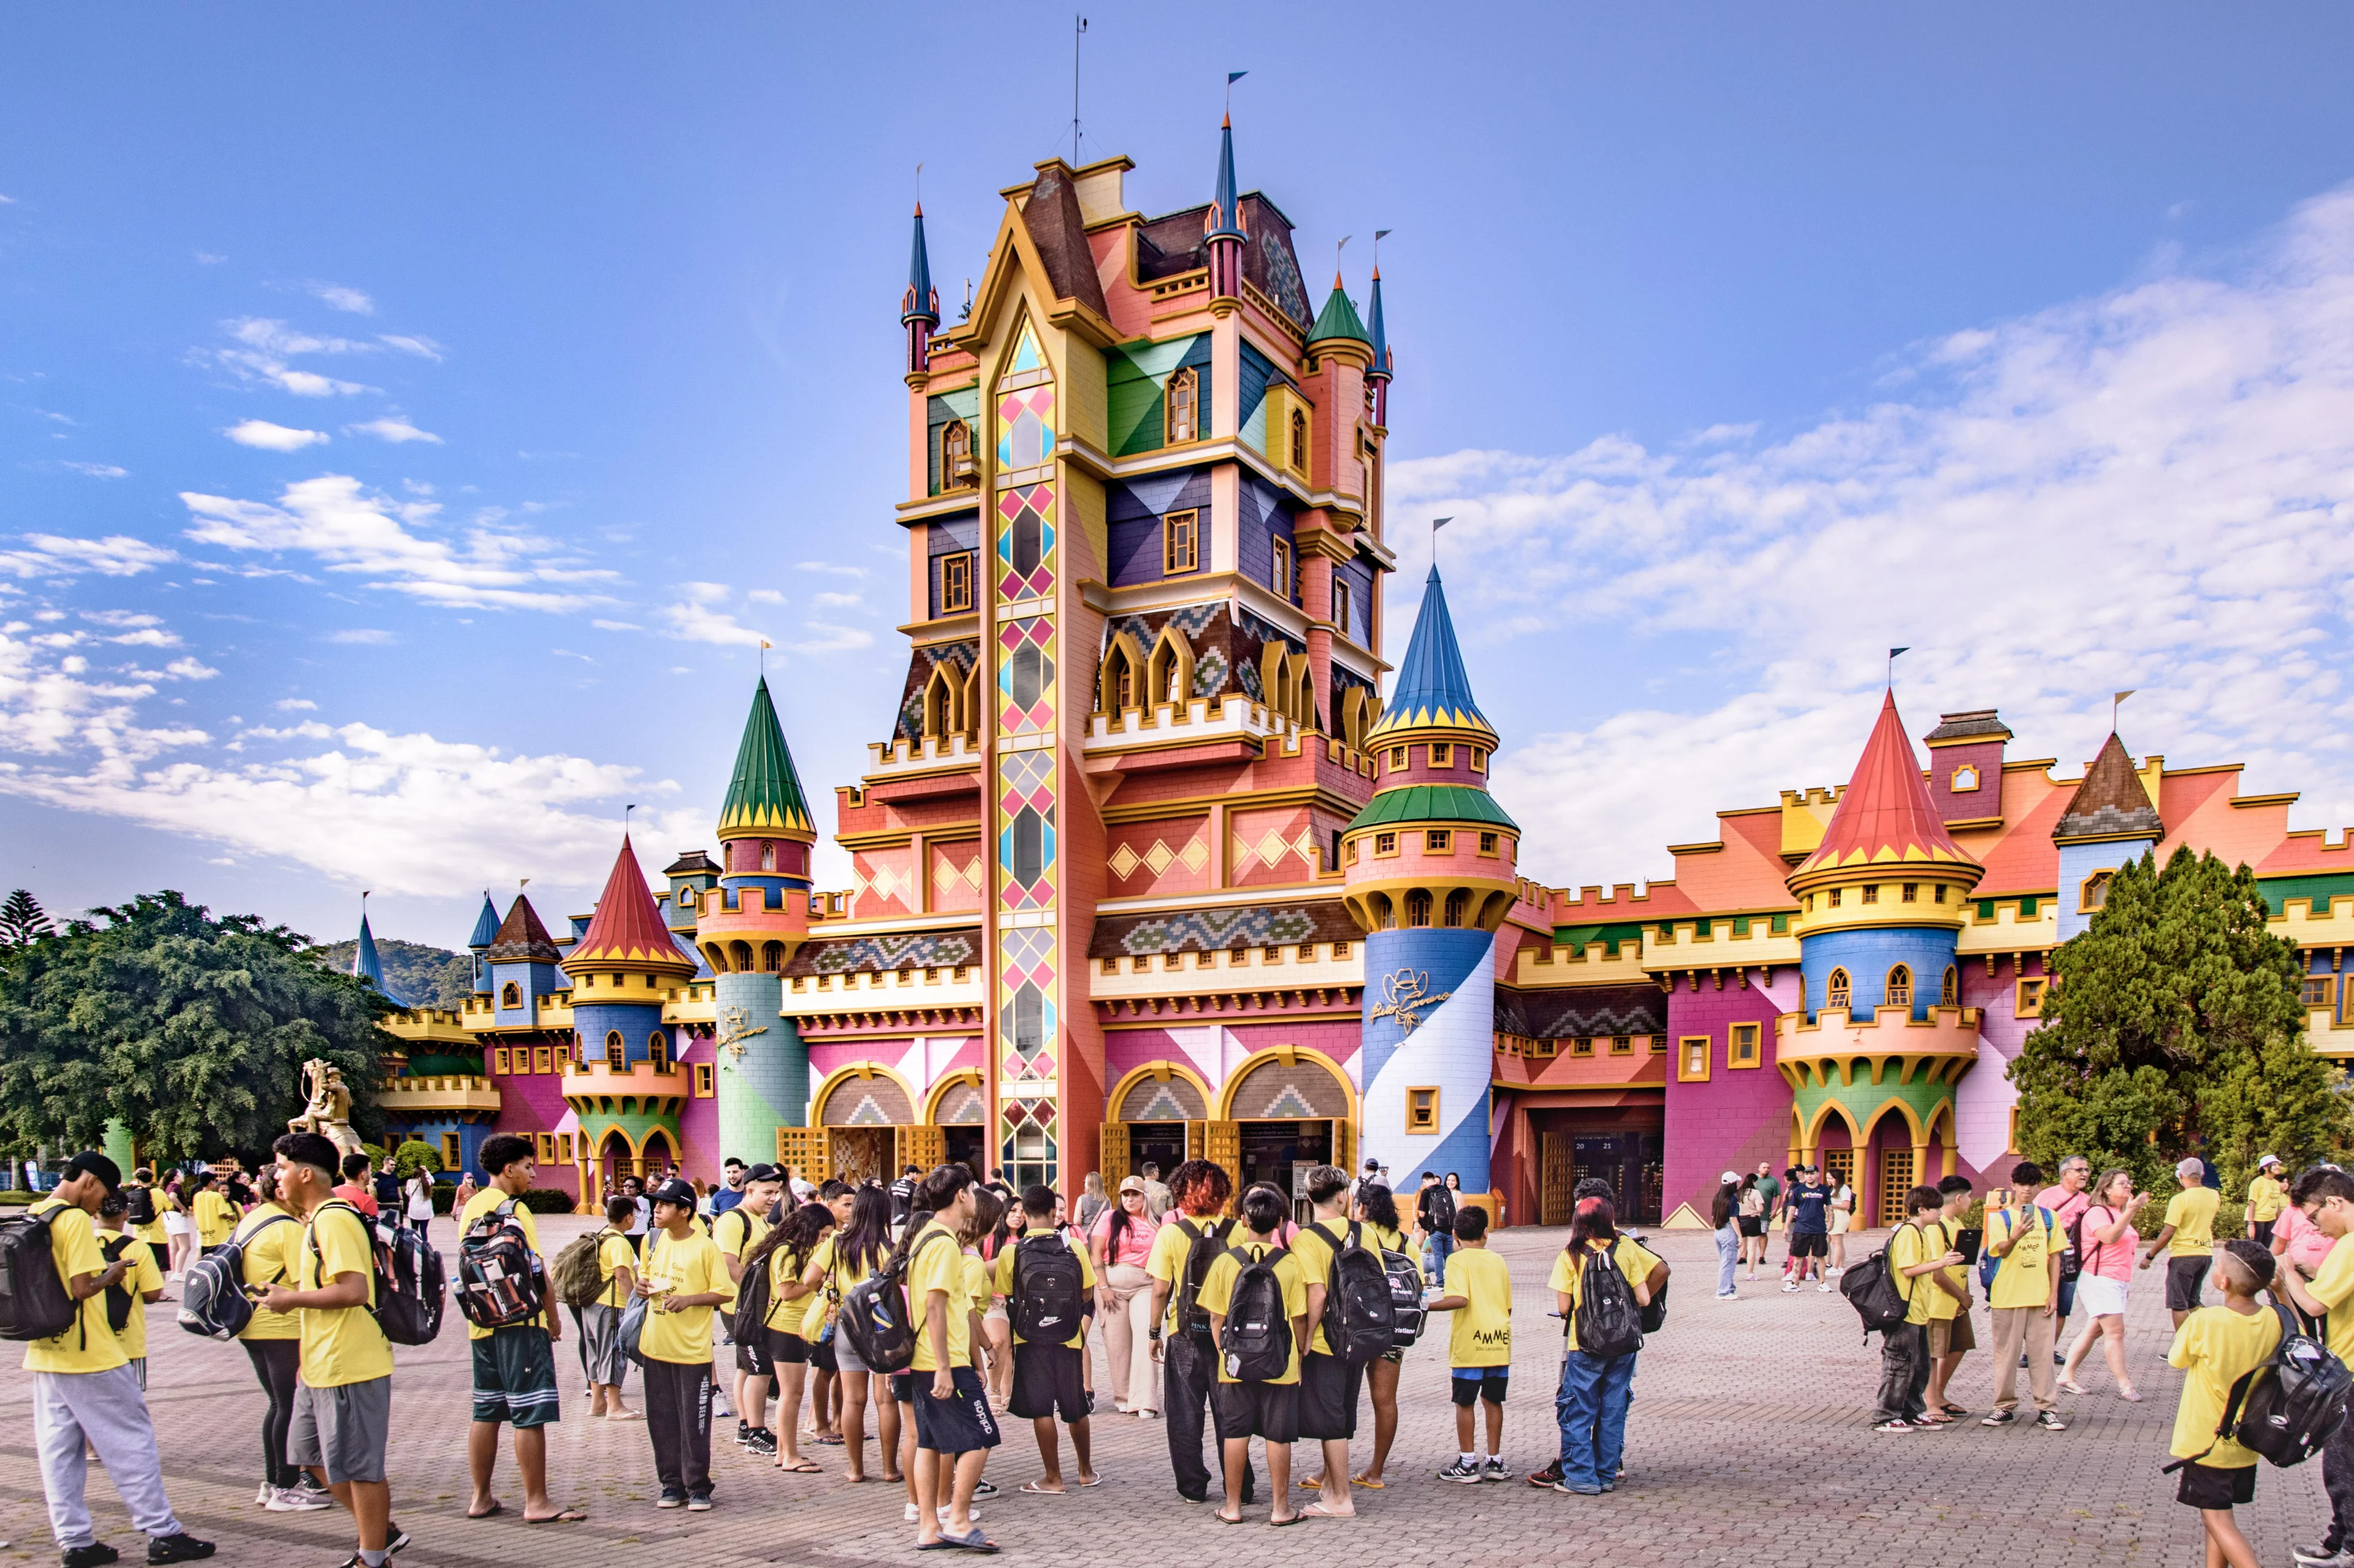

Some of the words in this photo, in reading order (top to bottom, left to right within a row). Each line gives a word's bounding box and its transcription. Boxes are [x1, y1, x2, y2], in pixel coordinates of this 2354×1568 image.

[1368, 1000, 1398, 1024] Beto
[1399, 990, 1452, 1012] Carrero
[2017, 1243, 2040, 1252] AMMEP
[699, 1381, 710, 1404] ISLAND
[698, 1405, 707, 1419] SEA
[973, 1399, 993, 1434] adidas
